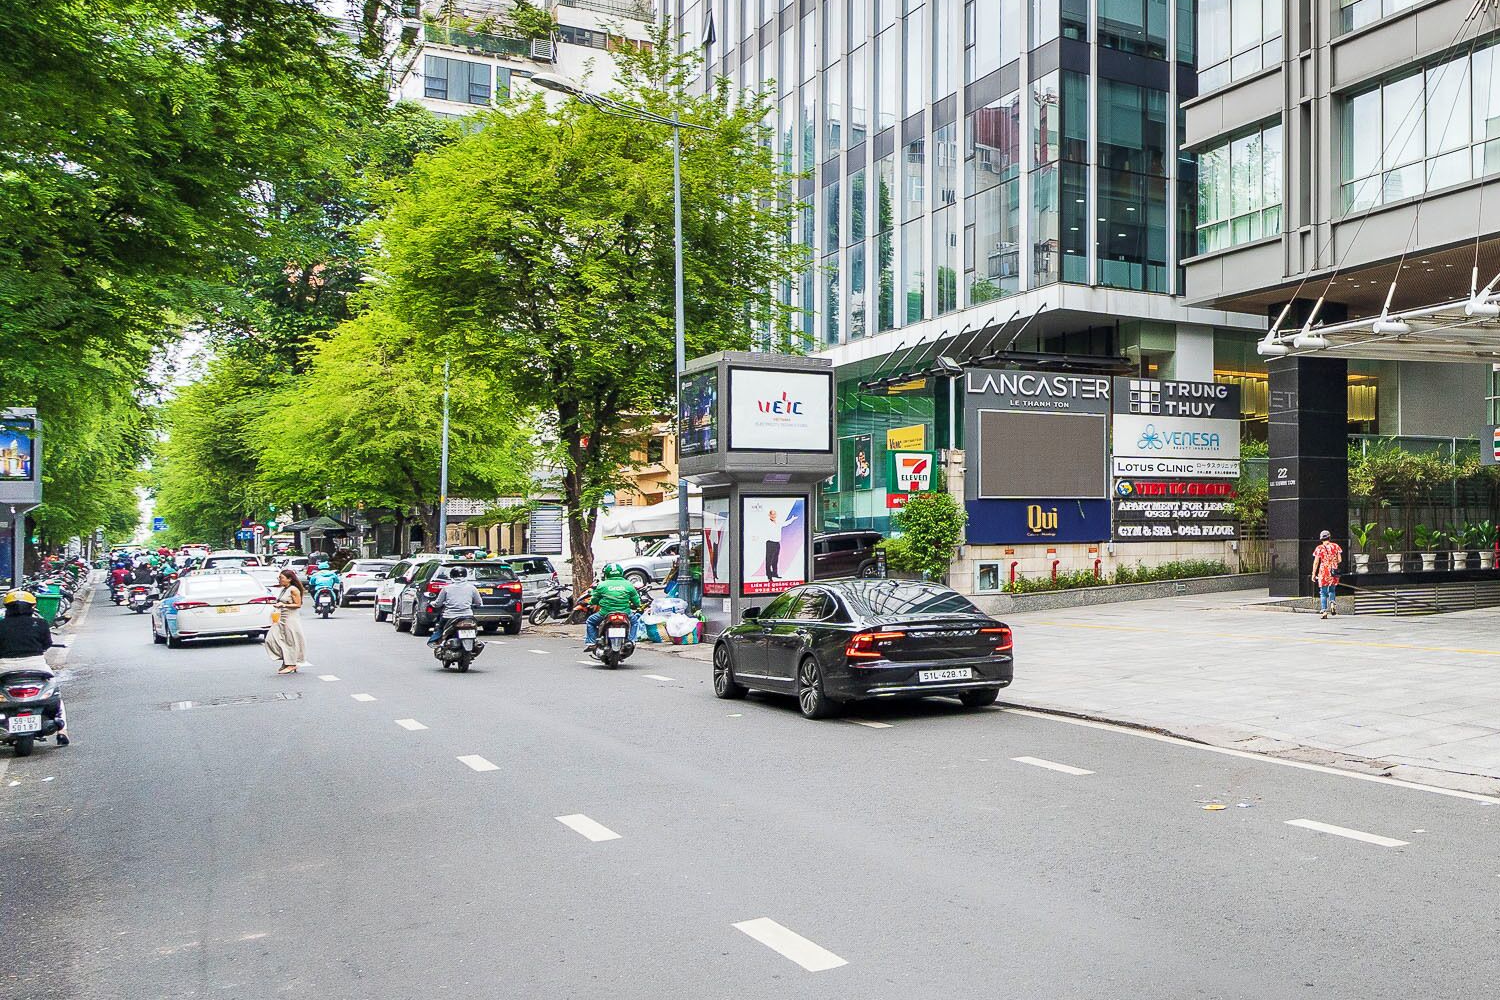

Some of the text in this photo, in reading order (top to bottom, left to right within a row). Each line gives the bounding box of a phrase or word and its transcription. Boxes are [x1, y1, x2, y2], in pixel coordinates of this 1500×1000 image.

[967, 372, 1109, 398] LANCASTER
[1165, 382, 1228, 399] TRUNG
[1165, 401, 1216, 416] THUY
[1162, 431, 1220, 447] VENESA
[1277, 467, 1288, 478] 22
[1118, 502, 1180, 511] APARTMENT
[1181, 502, 1203, 511] FOR
[1027, 504, 1058, 532] Qui
[1118, 525, 1142, 536] GYM
[1143, 525, 1152, 536] &
[1152, 525, 1172, 536] SPA
[1202, 526, 1234, 536] FLOOR
